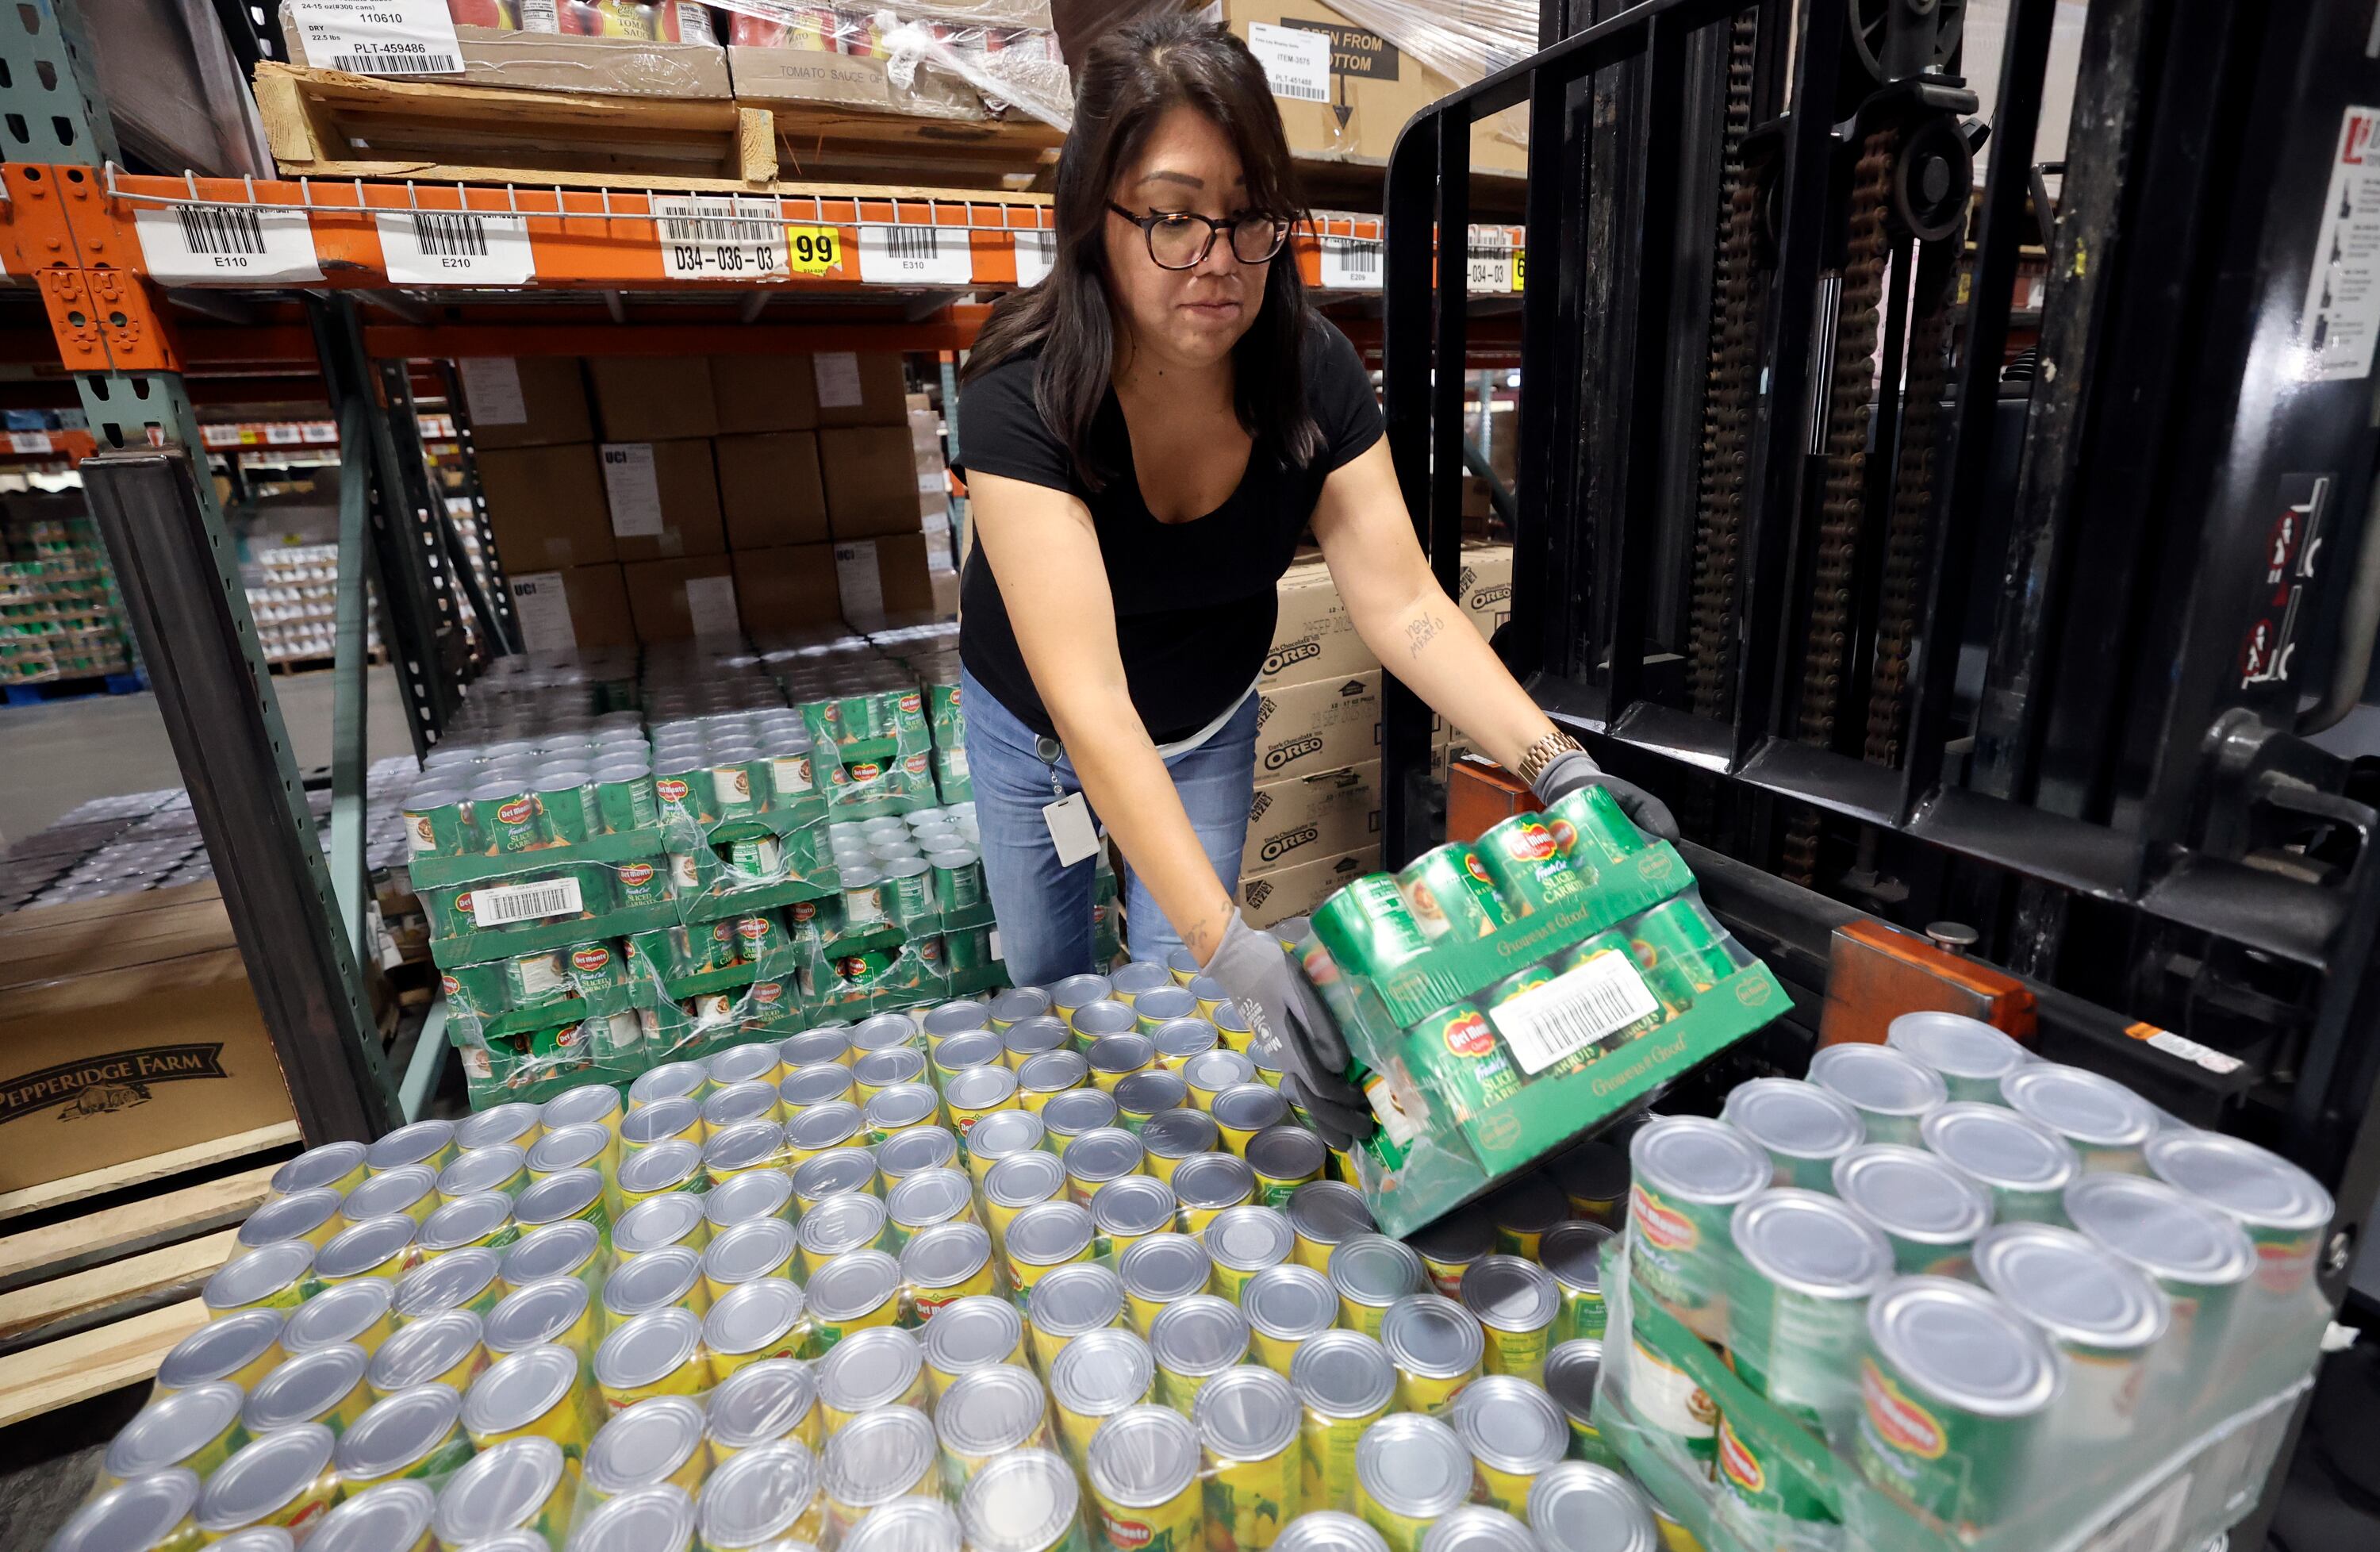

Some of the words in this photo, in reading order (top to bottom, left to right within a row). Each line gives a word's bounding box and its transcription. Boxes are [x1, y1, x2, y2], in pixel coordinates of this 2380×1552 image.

[360, 13, 402, 23] 110610
[617, 18, 650, 32] TOMA
[624, 28, 650, 40] SAUC
[1343, 33, 1383, 52] FROM
[354, 44, 425, 53] PLT-459486
[1330, 53, 1372, 71] OTTOM
[780, 65, 826, 79] TOMATO
[831, 69, 865, 83] SAUCE
[796, 235, 833, 263] 99
[214, 257, 248, 268] E110
[442, 258, 470, 268] E210
[903, 261, 925, 271] E310
[605, 451, 627, 463] UCI
[515, 583, 536, 597] UCI
[1471, 587, 1511, 609] OREO
[1404, 612, 1430, 638] NEW
[1280, 636, 1310, 651] Chocolate
[1263, 643, 1320, 675] OREO
[1257, 701, 1277, 729] SIZE!
[1269, 742, 1283, 751] Dark
[1283, 732, 1314, 746] Chocolate
[1265, 737, 1322, 770] OREO
[501, 809, 516, 820] Del
[1251, 795, 1273, 823] SIZE!
[1279, 825, 1309, 839] Chocolate
[1261, 828, 1318, 862] OREO
[631, 866, 652, 878] Monte
[1542, 870, 1576, 891] SLICED
[627, 893, 653, 902] SLICED
[1253, 883, 1274, 910] SIZE!
[1497, 920, 1548, 957] Growers
[1556, 902, 1590, 930] Good
[575, 955, 586, 965] Del
[586, 952, 608, 964] Monte
[559, 1032, 571, 1043] Del
[1449, 1031, 1468, 1050] Del
[1466, 1022, 1491, 1041] Mon
[136, 1053, 203, 1076] FARM
[1552, 1047, 1596, 1077] ARROTS
[1591, 1060, 1645, 1097] Growers
[1650, 1034, 1687, 1064] Good
[1111, 1520, 1150, 1539] Monte
